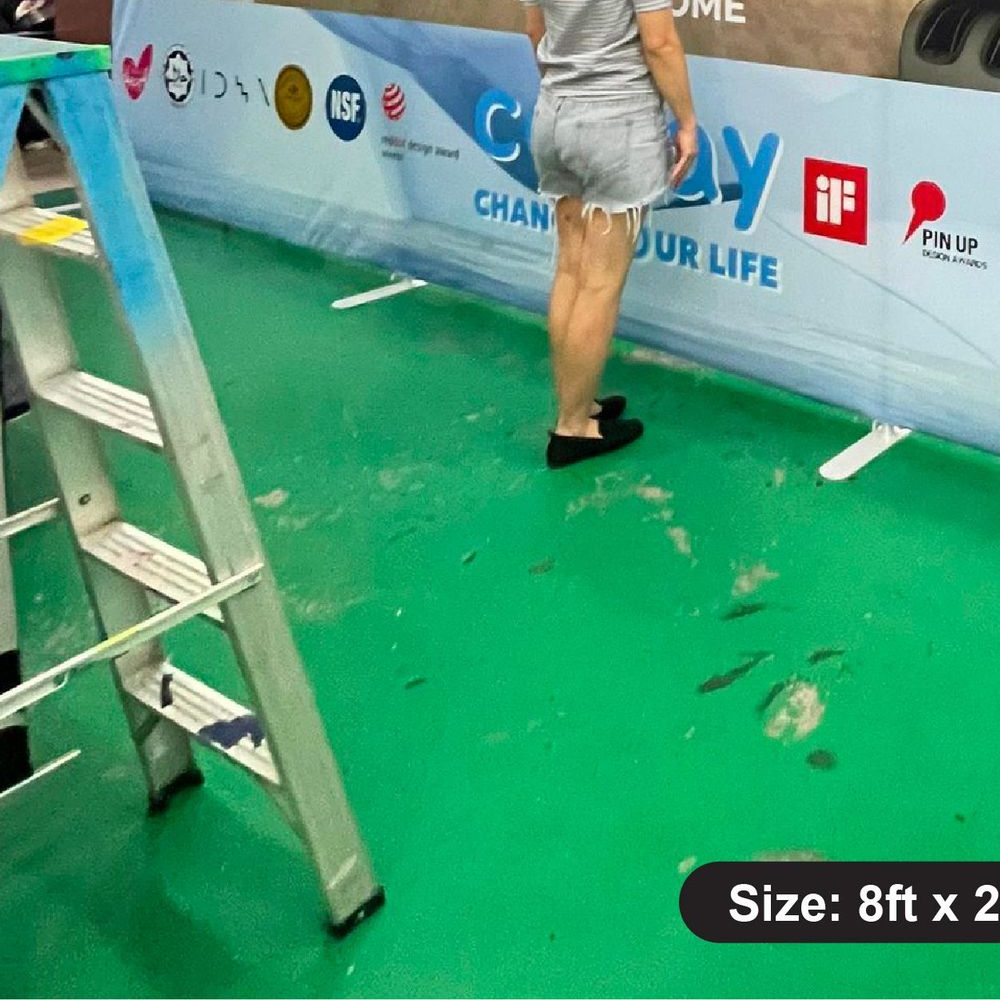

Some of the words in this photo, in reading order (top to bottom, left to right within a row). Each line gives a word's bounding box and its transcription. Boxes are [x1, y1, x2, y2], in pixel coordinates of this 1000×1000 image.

[331, 90, 361, 123] NSF
[922, 228, 951, 250] PIN
[956, 234, 978, 256] UP
[710, 243, 778, 290] LIFE
